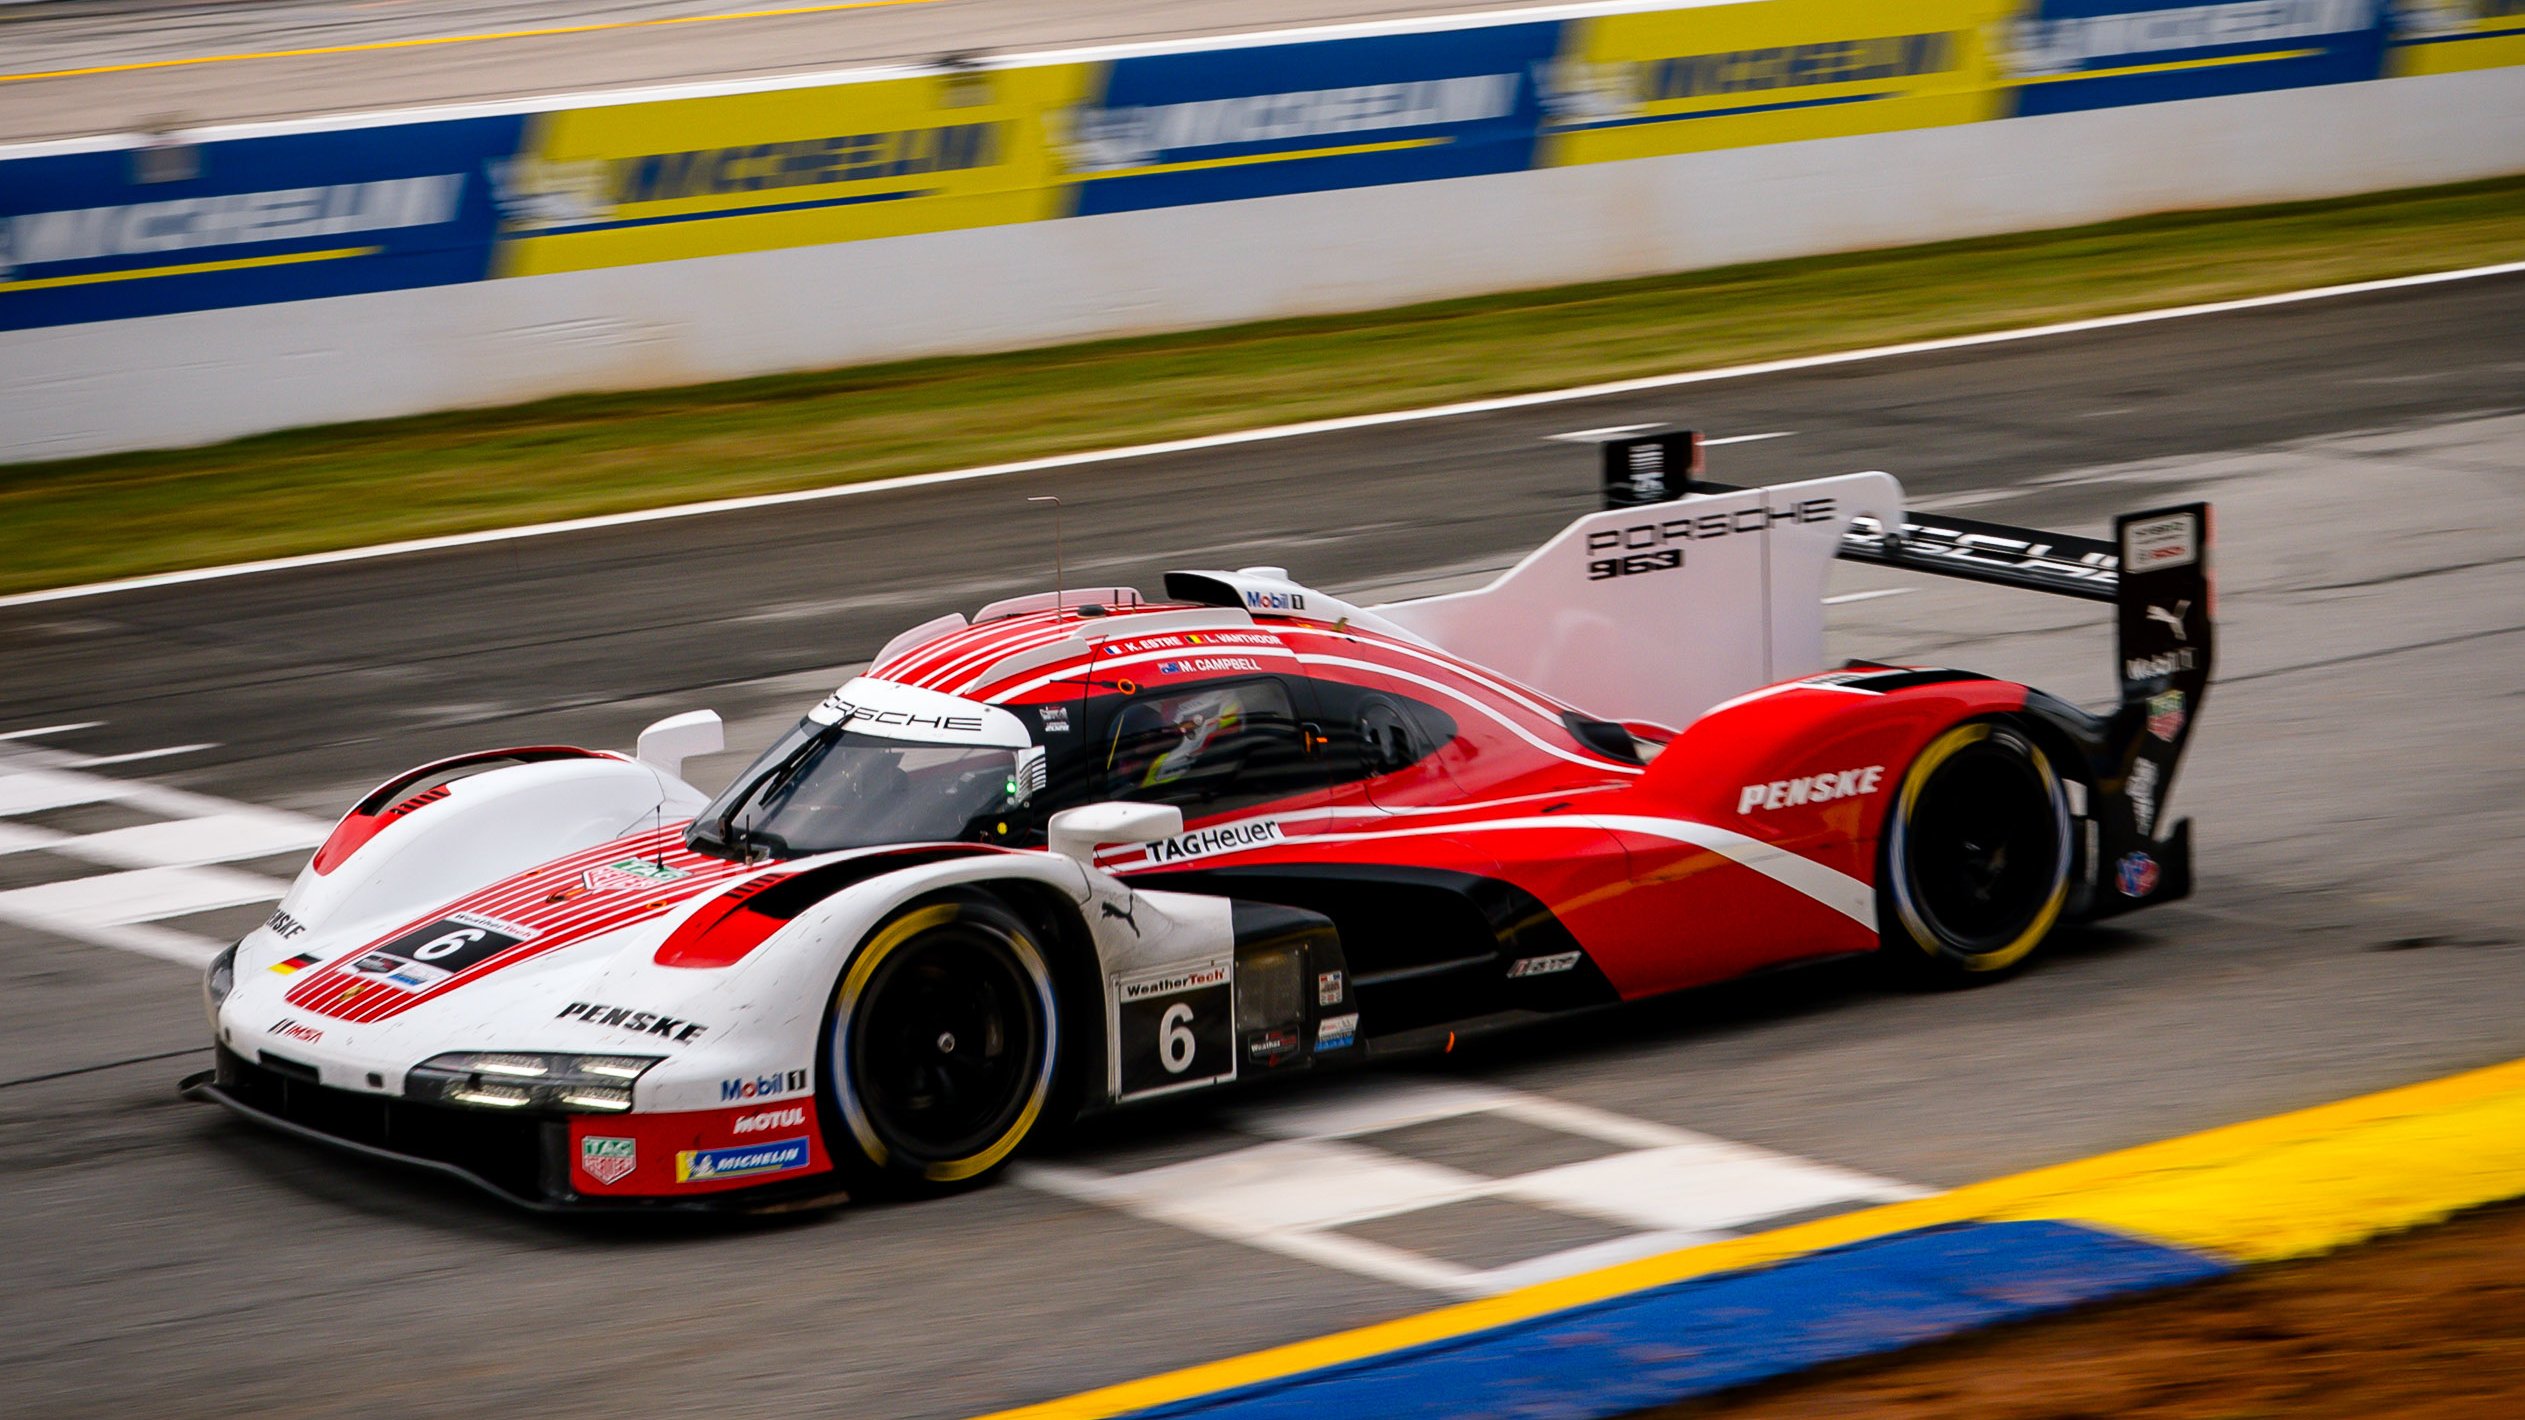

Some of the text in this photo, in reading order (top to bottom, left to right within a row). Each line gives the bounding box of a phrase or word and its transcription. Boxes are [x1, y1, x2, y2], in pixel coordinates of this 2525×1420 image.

[1587, 498, 1837, 555] PORSCHE
[1587, 549, 1685, 580] 963
[1247, 591, 1305, 610] Mobil 1
[1125, 642, 1142, 651] K.
[1204, 633, 1217, 643] L.
[1216, 633, 1283, 645] VANTHOOR
[1179, 657, 1262, 672] M. CAMPBELL
[1737, 765, 1885, 815] PENSKE
[413, 928, 486, 960] 6
[1127, 967, 1225, 997] WeatherTech
[555, 1001, 709, 1047] PENSKE
[1160, 1003, 1195, 1074] 6
[721, 1070, 806, 1101] Mobil 1
[733, 1107, 806, 1134] MOTUL
[584, 1139, 634, 1156] TAG
[715, 1147, 800, 1171] MICHELIN
